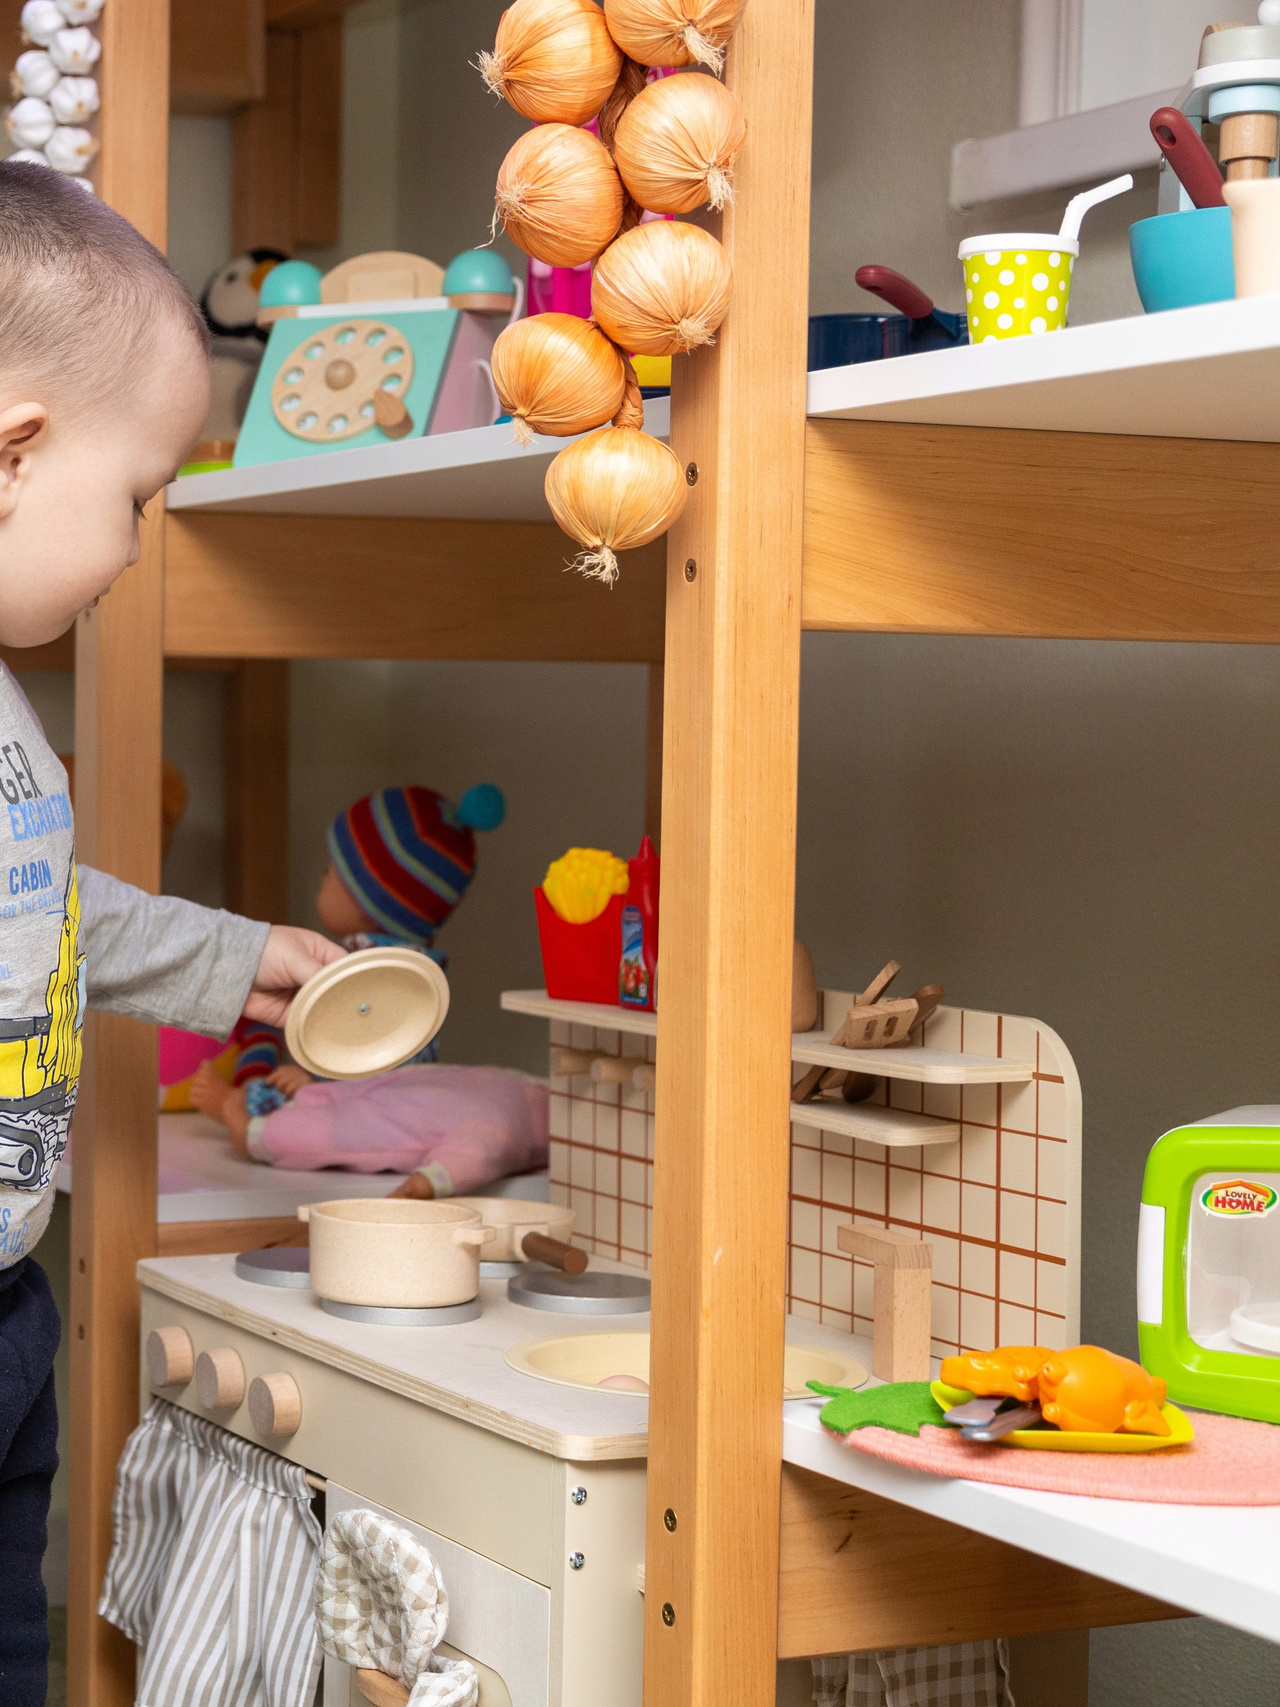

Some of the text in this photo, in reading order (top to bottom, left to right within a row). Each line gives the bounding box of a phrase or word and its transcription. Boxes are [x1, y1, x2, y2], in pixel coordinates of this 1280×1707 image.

[9, 859, 52, 896] CABIN
[19, 897, 36, 915] THE
[1213, 1195, 1265, 1213] HOME
[1225, 1190, 1258, 1200] LOVELY
